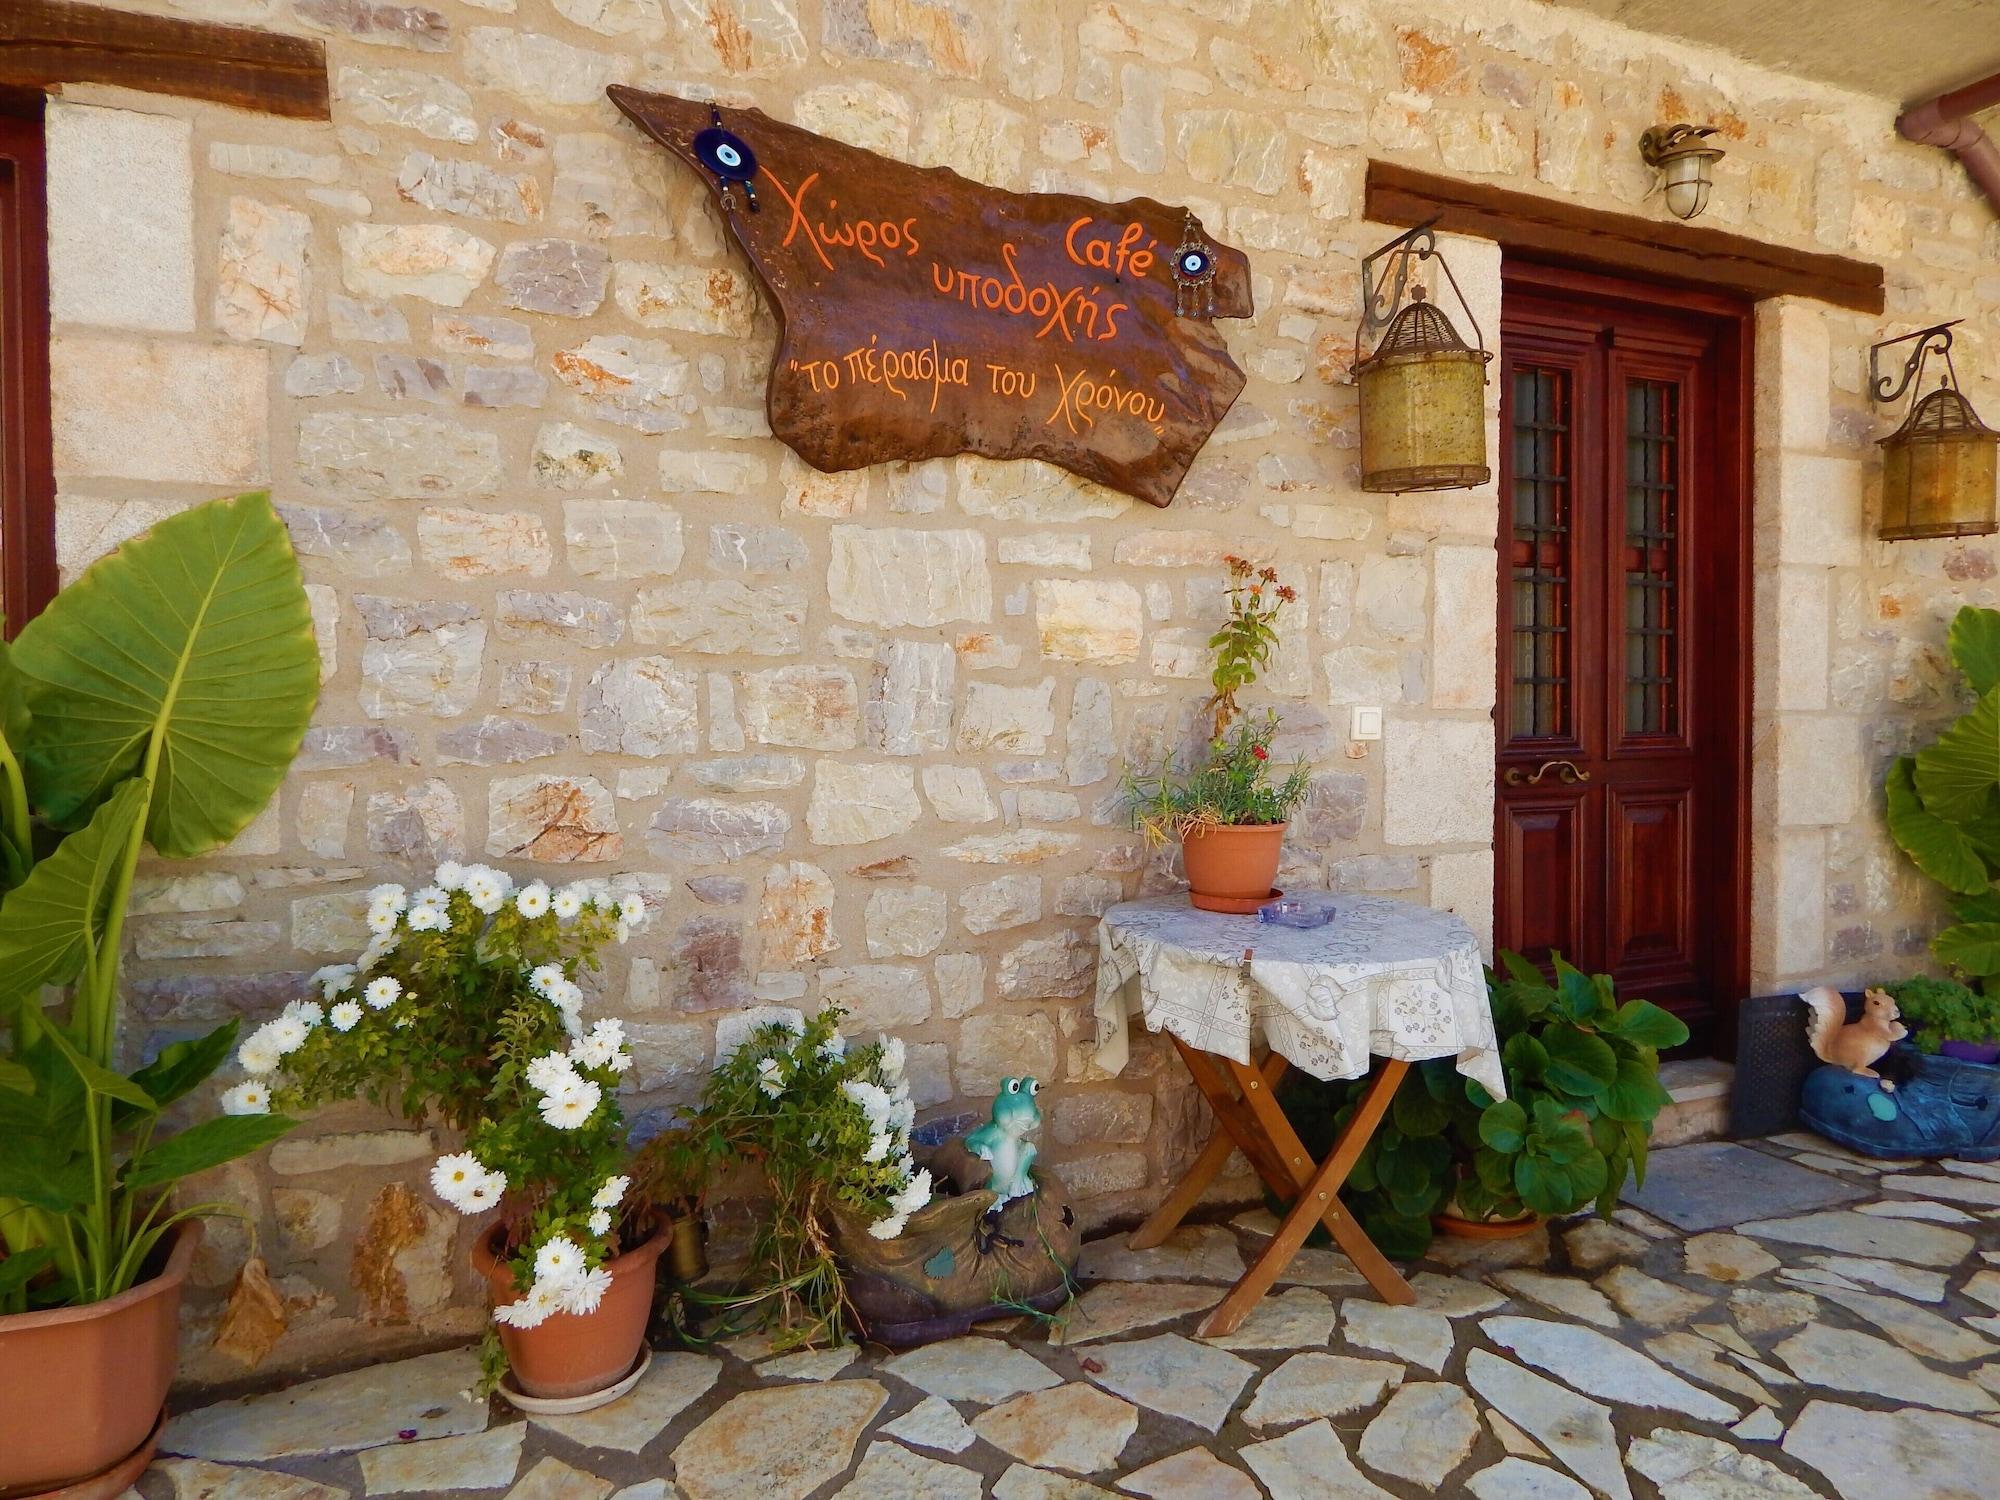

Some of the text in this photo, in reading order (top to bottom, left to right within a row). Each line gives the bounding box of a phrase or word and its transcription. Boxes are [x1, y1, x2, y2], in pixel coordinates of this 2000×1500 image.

[759, 164, 1129, 342] Χώρος υποδοχής
[1065, 216, 1158, 278] Café
